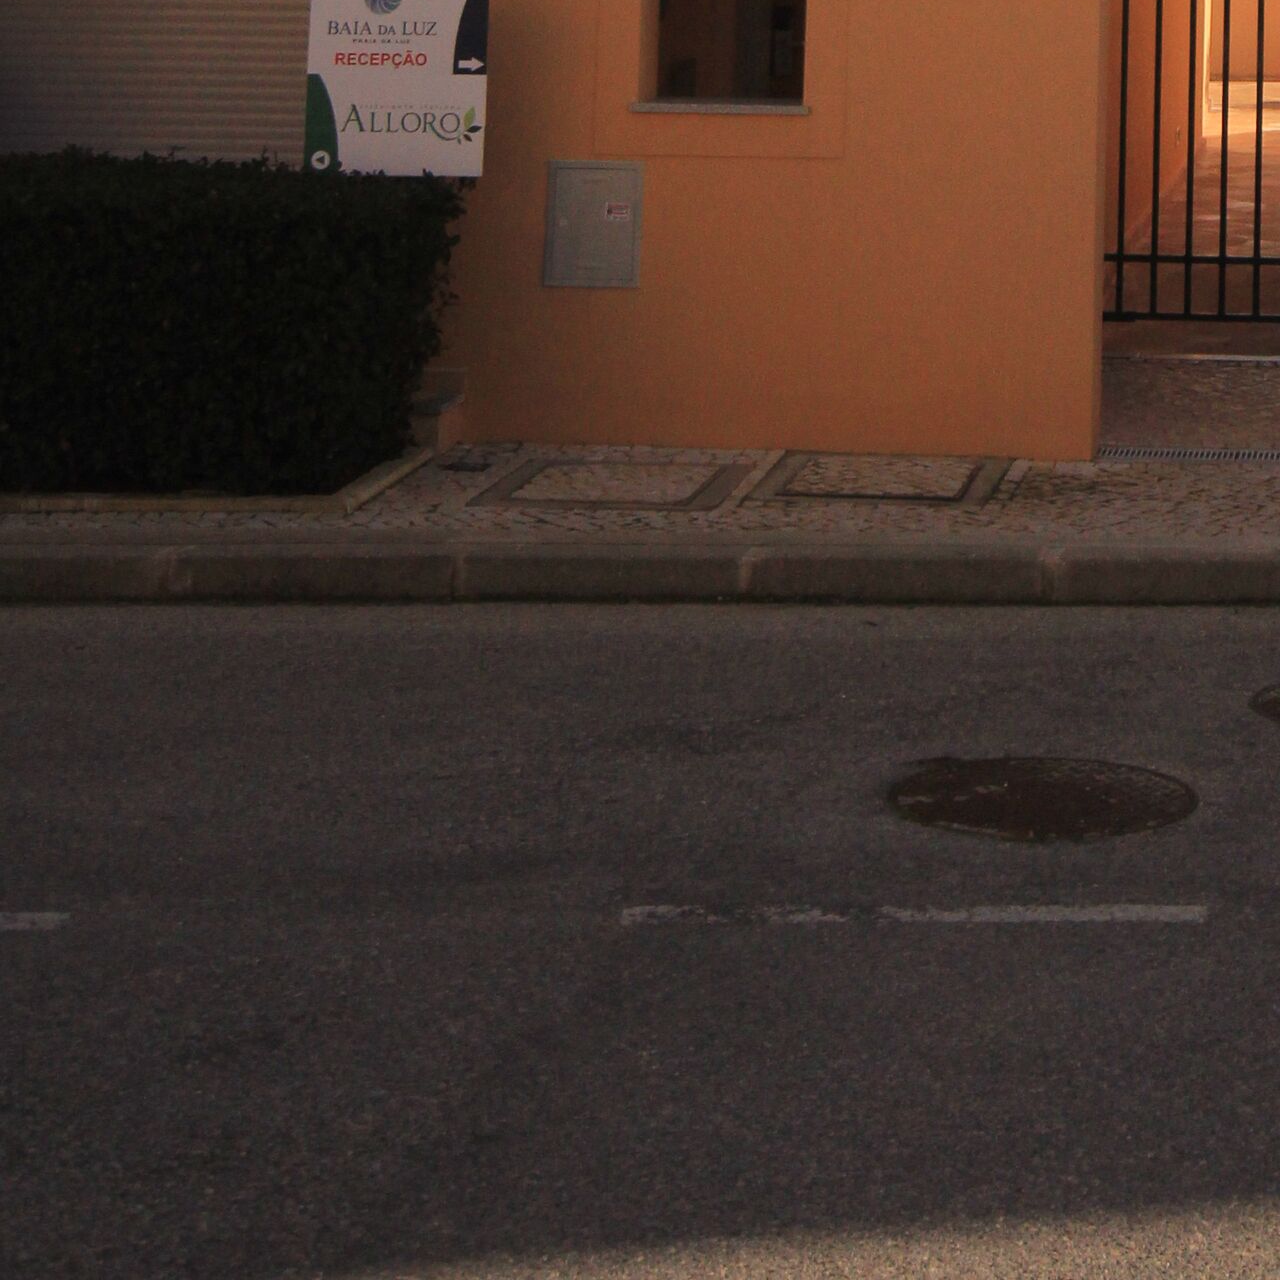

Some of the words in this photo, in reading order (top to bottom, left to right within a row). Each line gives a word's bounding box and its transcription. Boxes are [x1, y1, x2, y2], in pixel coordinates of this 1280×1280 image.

[378, 25, 396, 35] DA
[402, 21, 437, 36] LUZ
[335, 50, 427, 69] RECEPÇÃO
